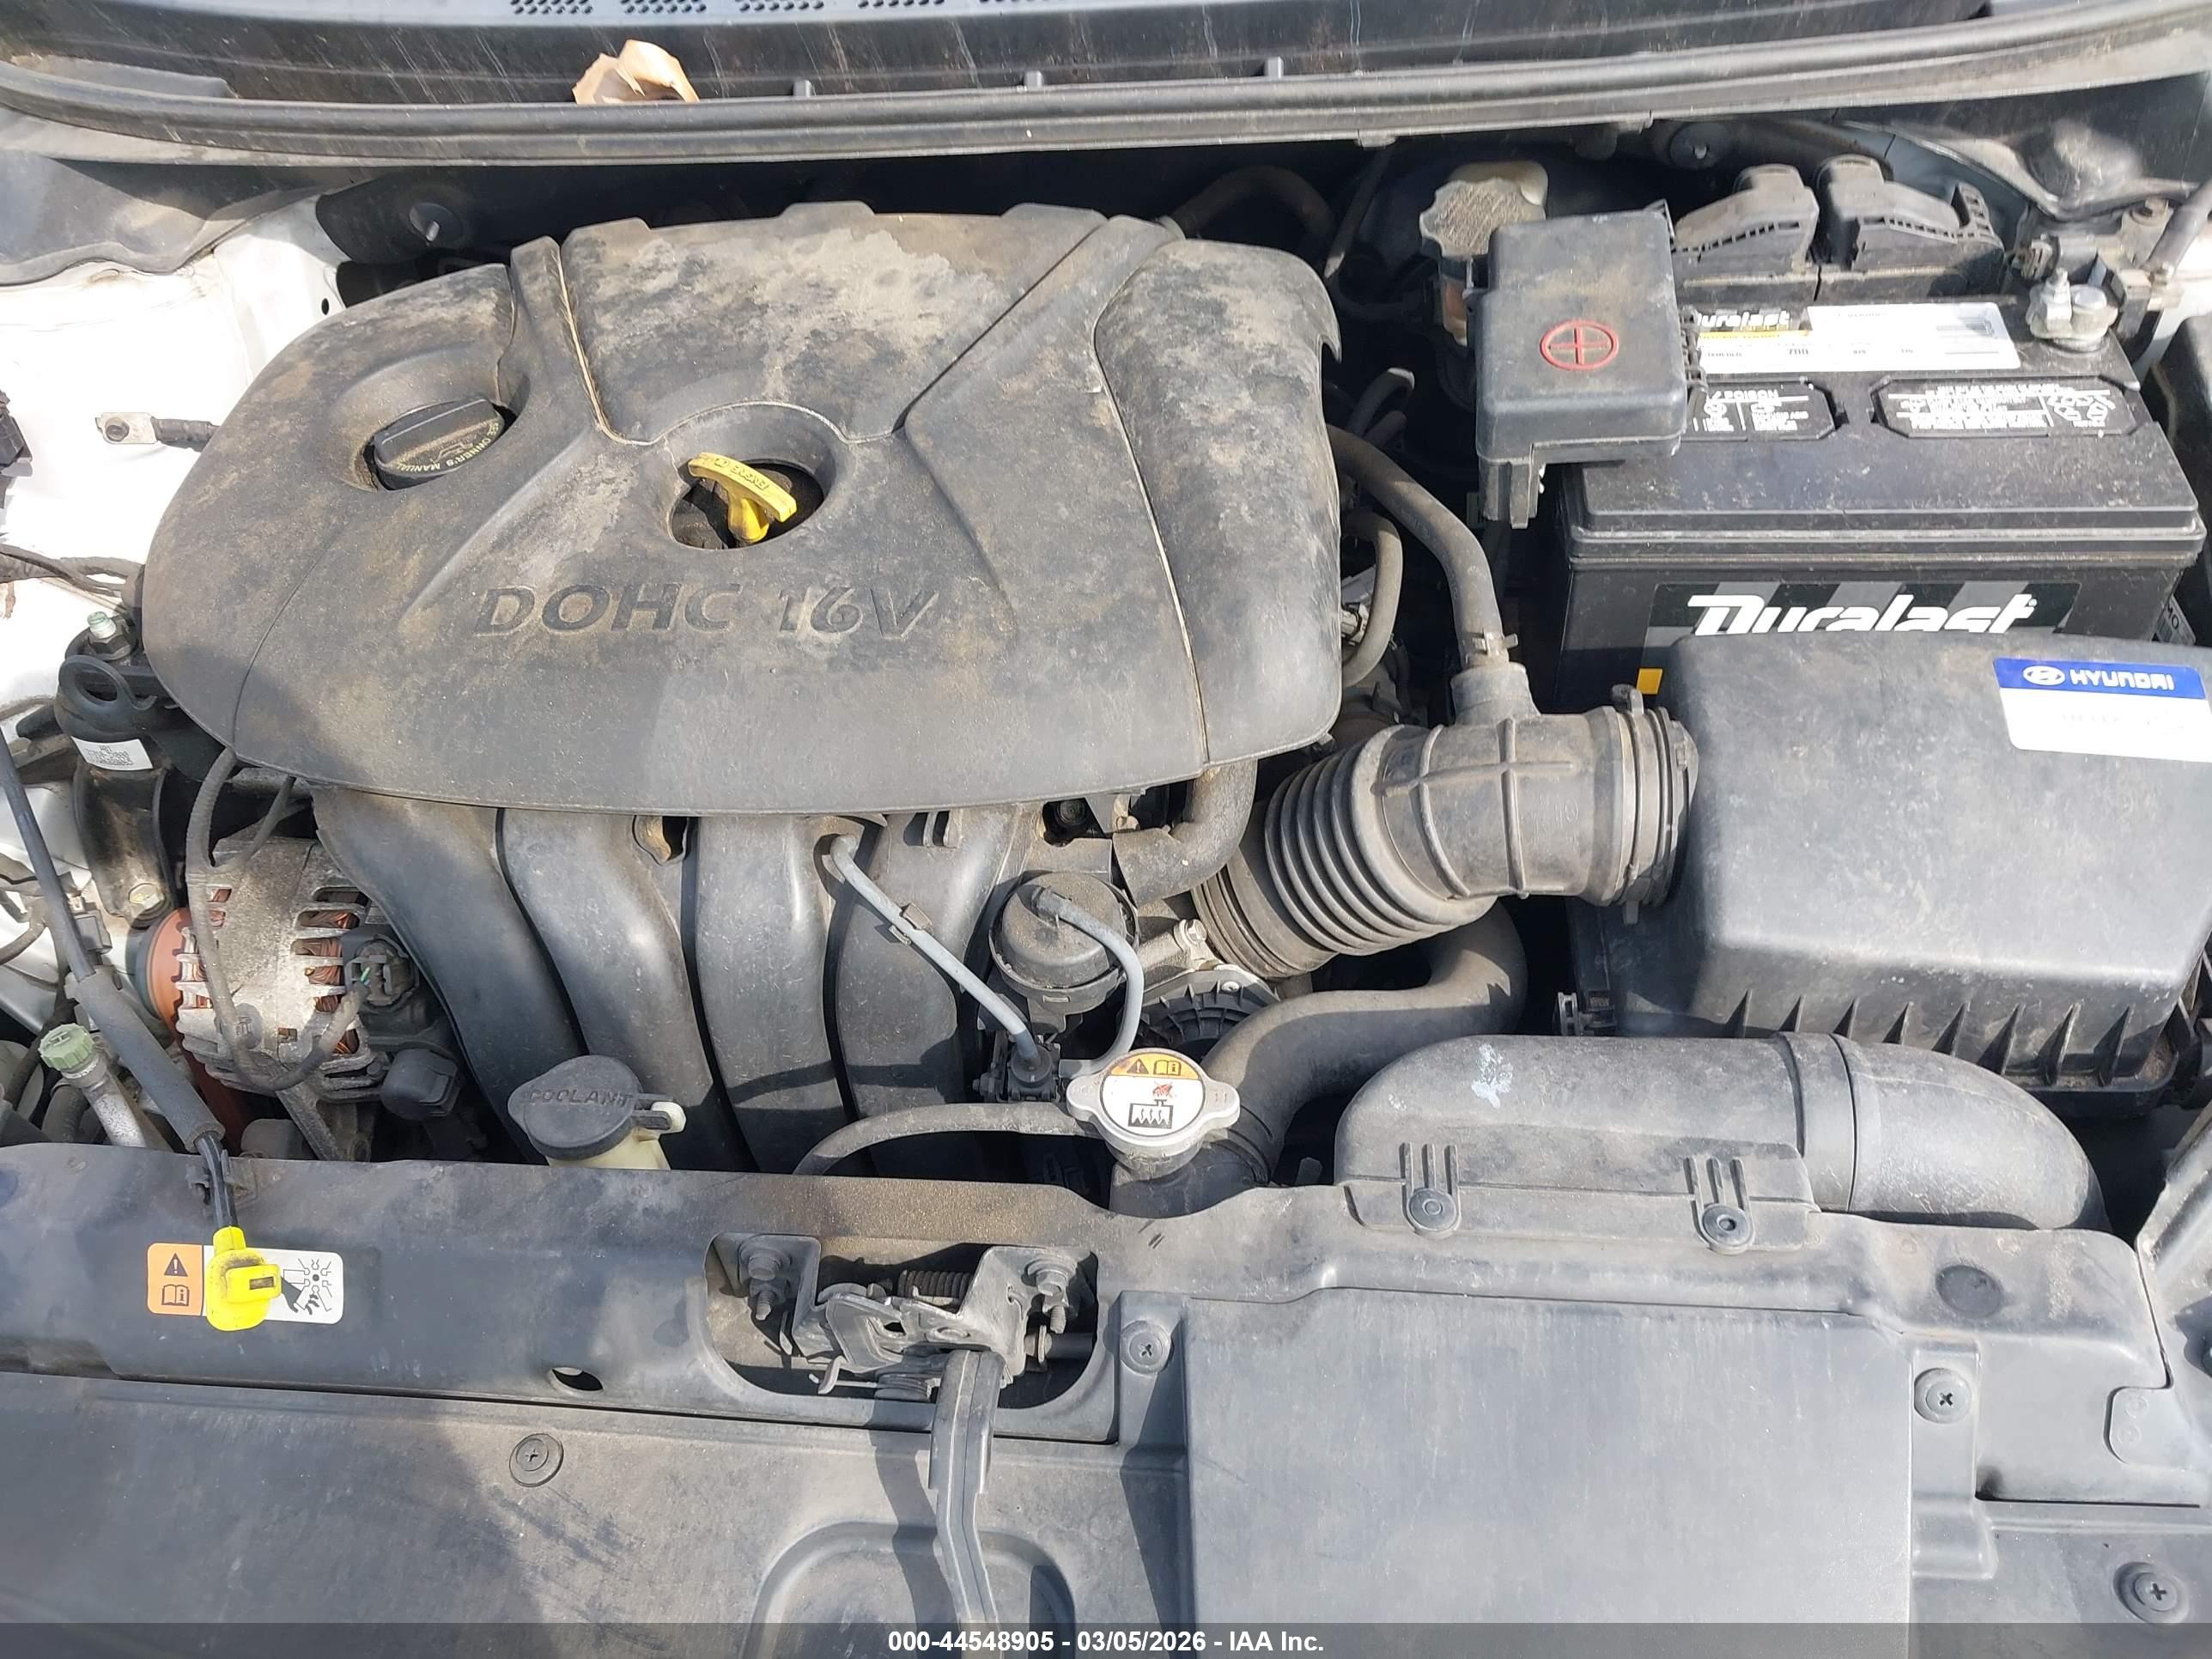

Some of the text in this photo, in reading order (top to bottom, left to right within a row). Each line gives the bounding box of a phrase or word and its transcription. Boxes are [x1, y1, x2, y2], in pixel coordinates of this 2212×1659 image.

[1697, 310, 1790, 327] uralast
[446, 437, 492, 467] OWNER'S
[472, 584, 940, 640] DOHC 16V
[1687, 593, 2033, 635] Duralast
[2069, 669, 2176, 691] HYUNDAI
[529, 1088, 635, 1109] COOLANT
